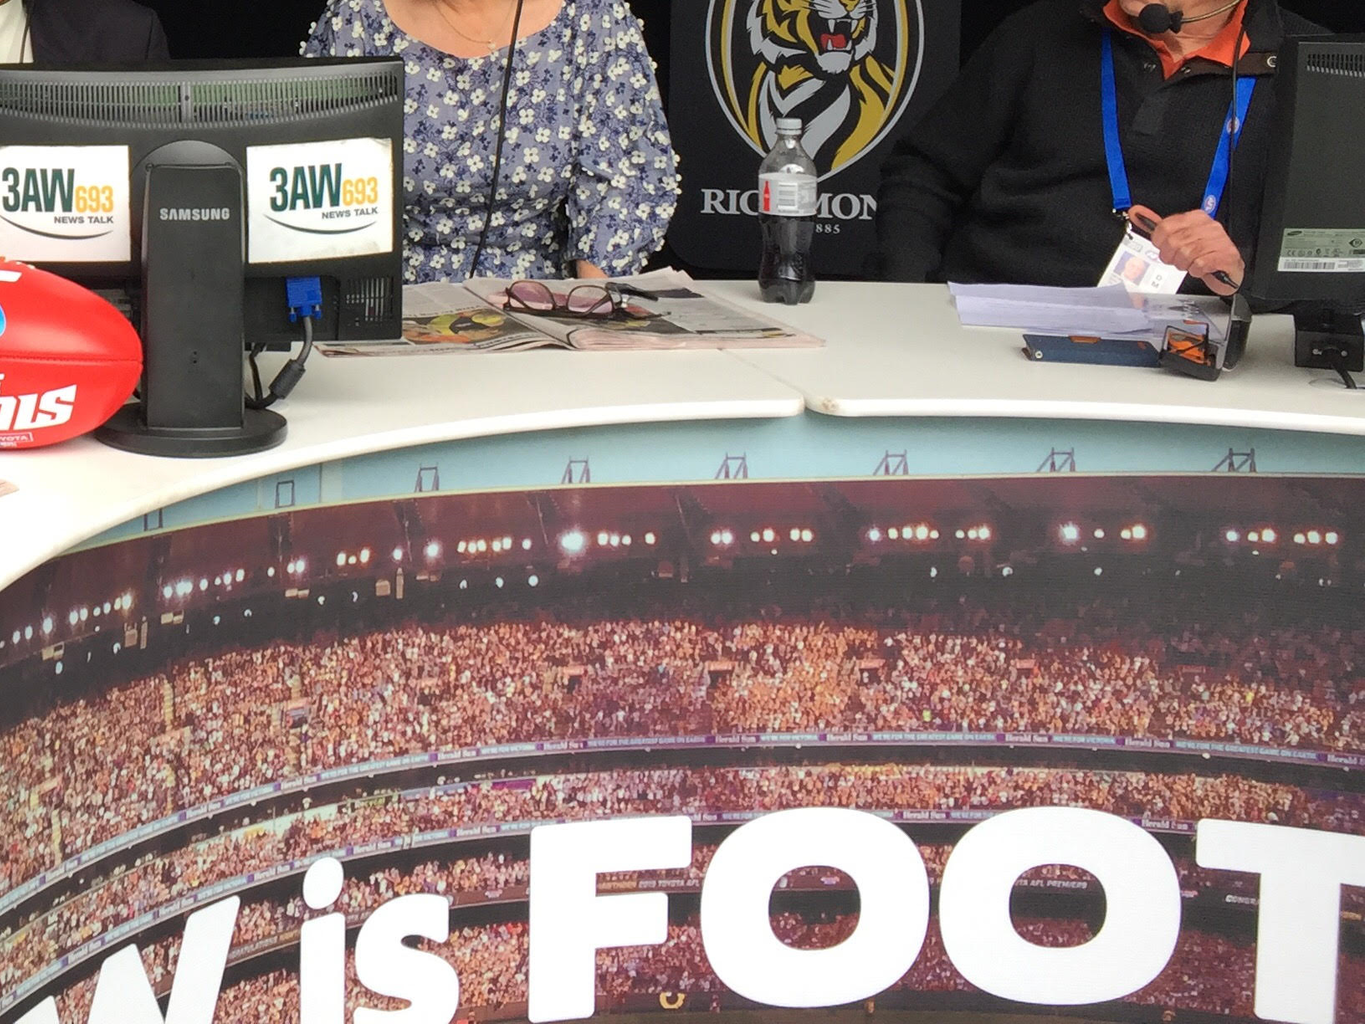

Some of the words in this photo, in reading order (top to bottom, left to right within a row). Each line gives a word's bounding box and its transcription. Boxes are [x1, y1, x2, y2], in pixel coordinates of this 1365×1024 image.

[1, 167, 75, 213] 3AW
[74, 185, 114, 213] 693
[269, 162, 344, 213] 3AW
[342, 176, 379, 207] 693
[54, 215, 85, 224] NEWS
[89, 215, 114, 224] TALK
[159, 207, 231, 221] SAMSUNG
[321, 209, 351, 220] NEWS
[354, 206, 379, 217] TALK
[700, 188, 877, 220] RICMON
[301, 857, 459, 1024] is
